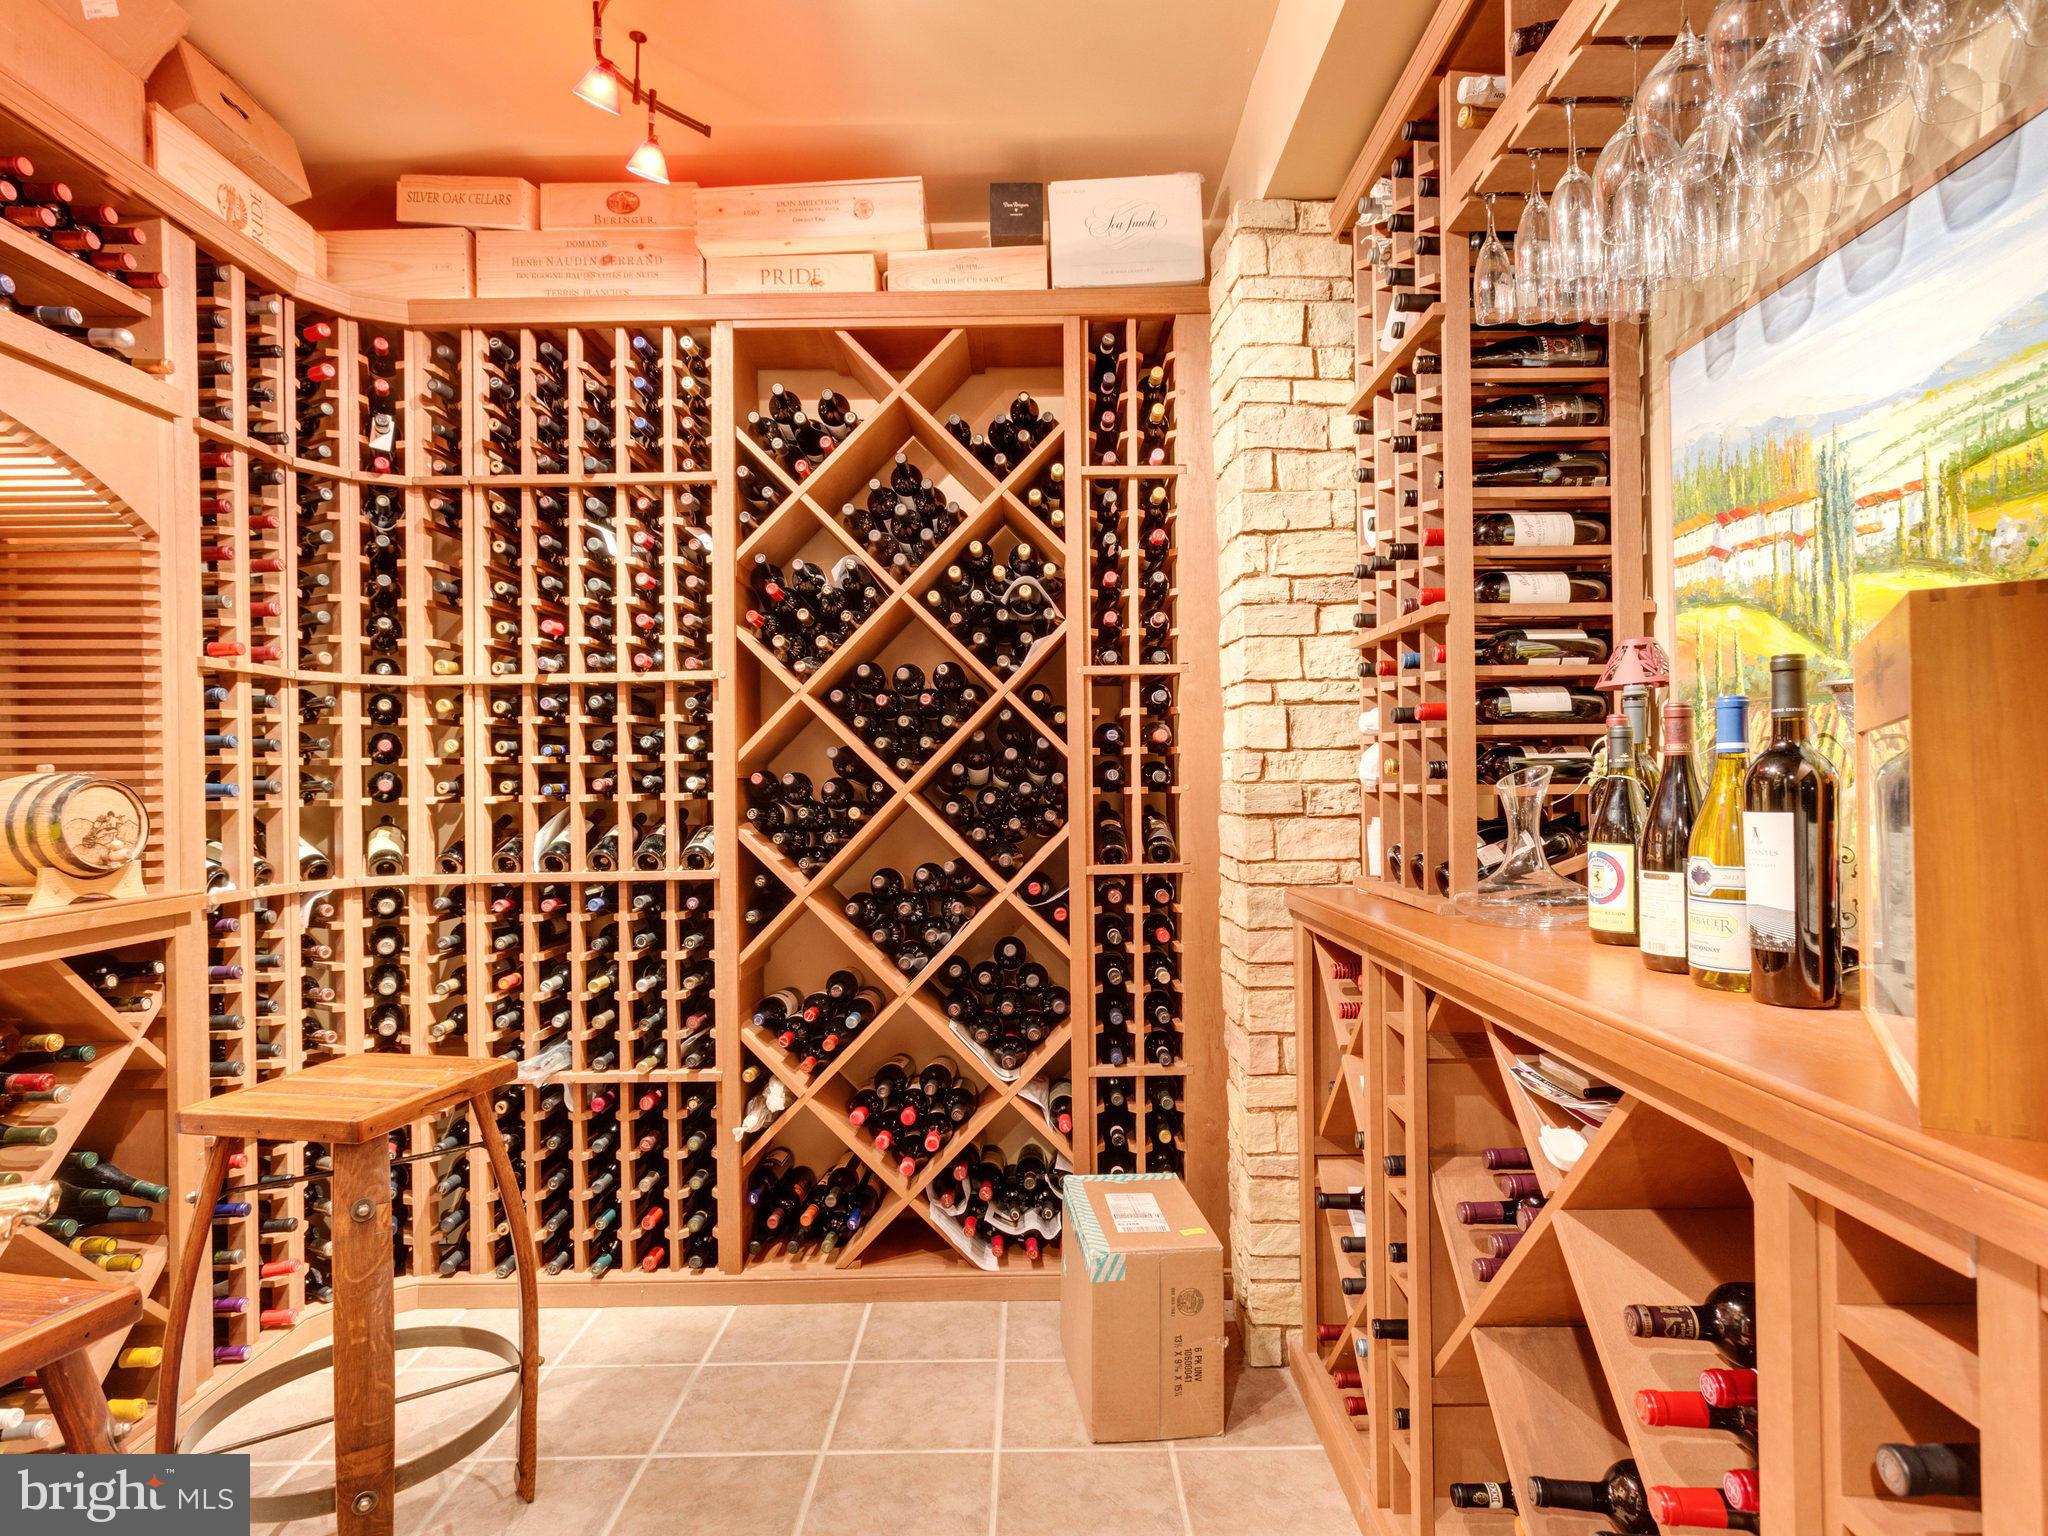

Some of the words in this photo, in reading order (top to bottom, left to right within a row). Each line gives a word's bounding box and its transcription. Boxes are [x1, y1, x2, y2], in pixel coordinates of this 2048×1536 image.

[406, 191, 440, 203] SILVER
[442, 192, 466, 204] OAK
[468, 193, 512, 206] CELLARS
[566, 240, 609, 248] DOMAINE
[545, 255, 598, 266] NAUDIN
[760, 267, 822, 286] PRIDE
